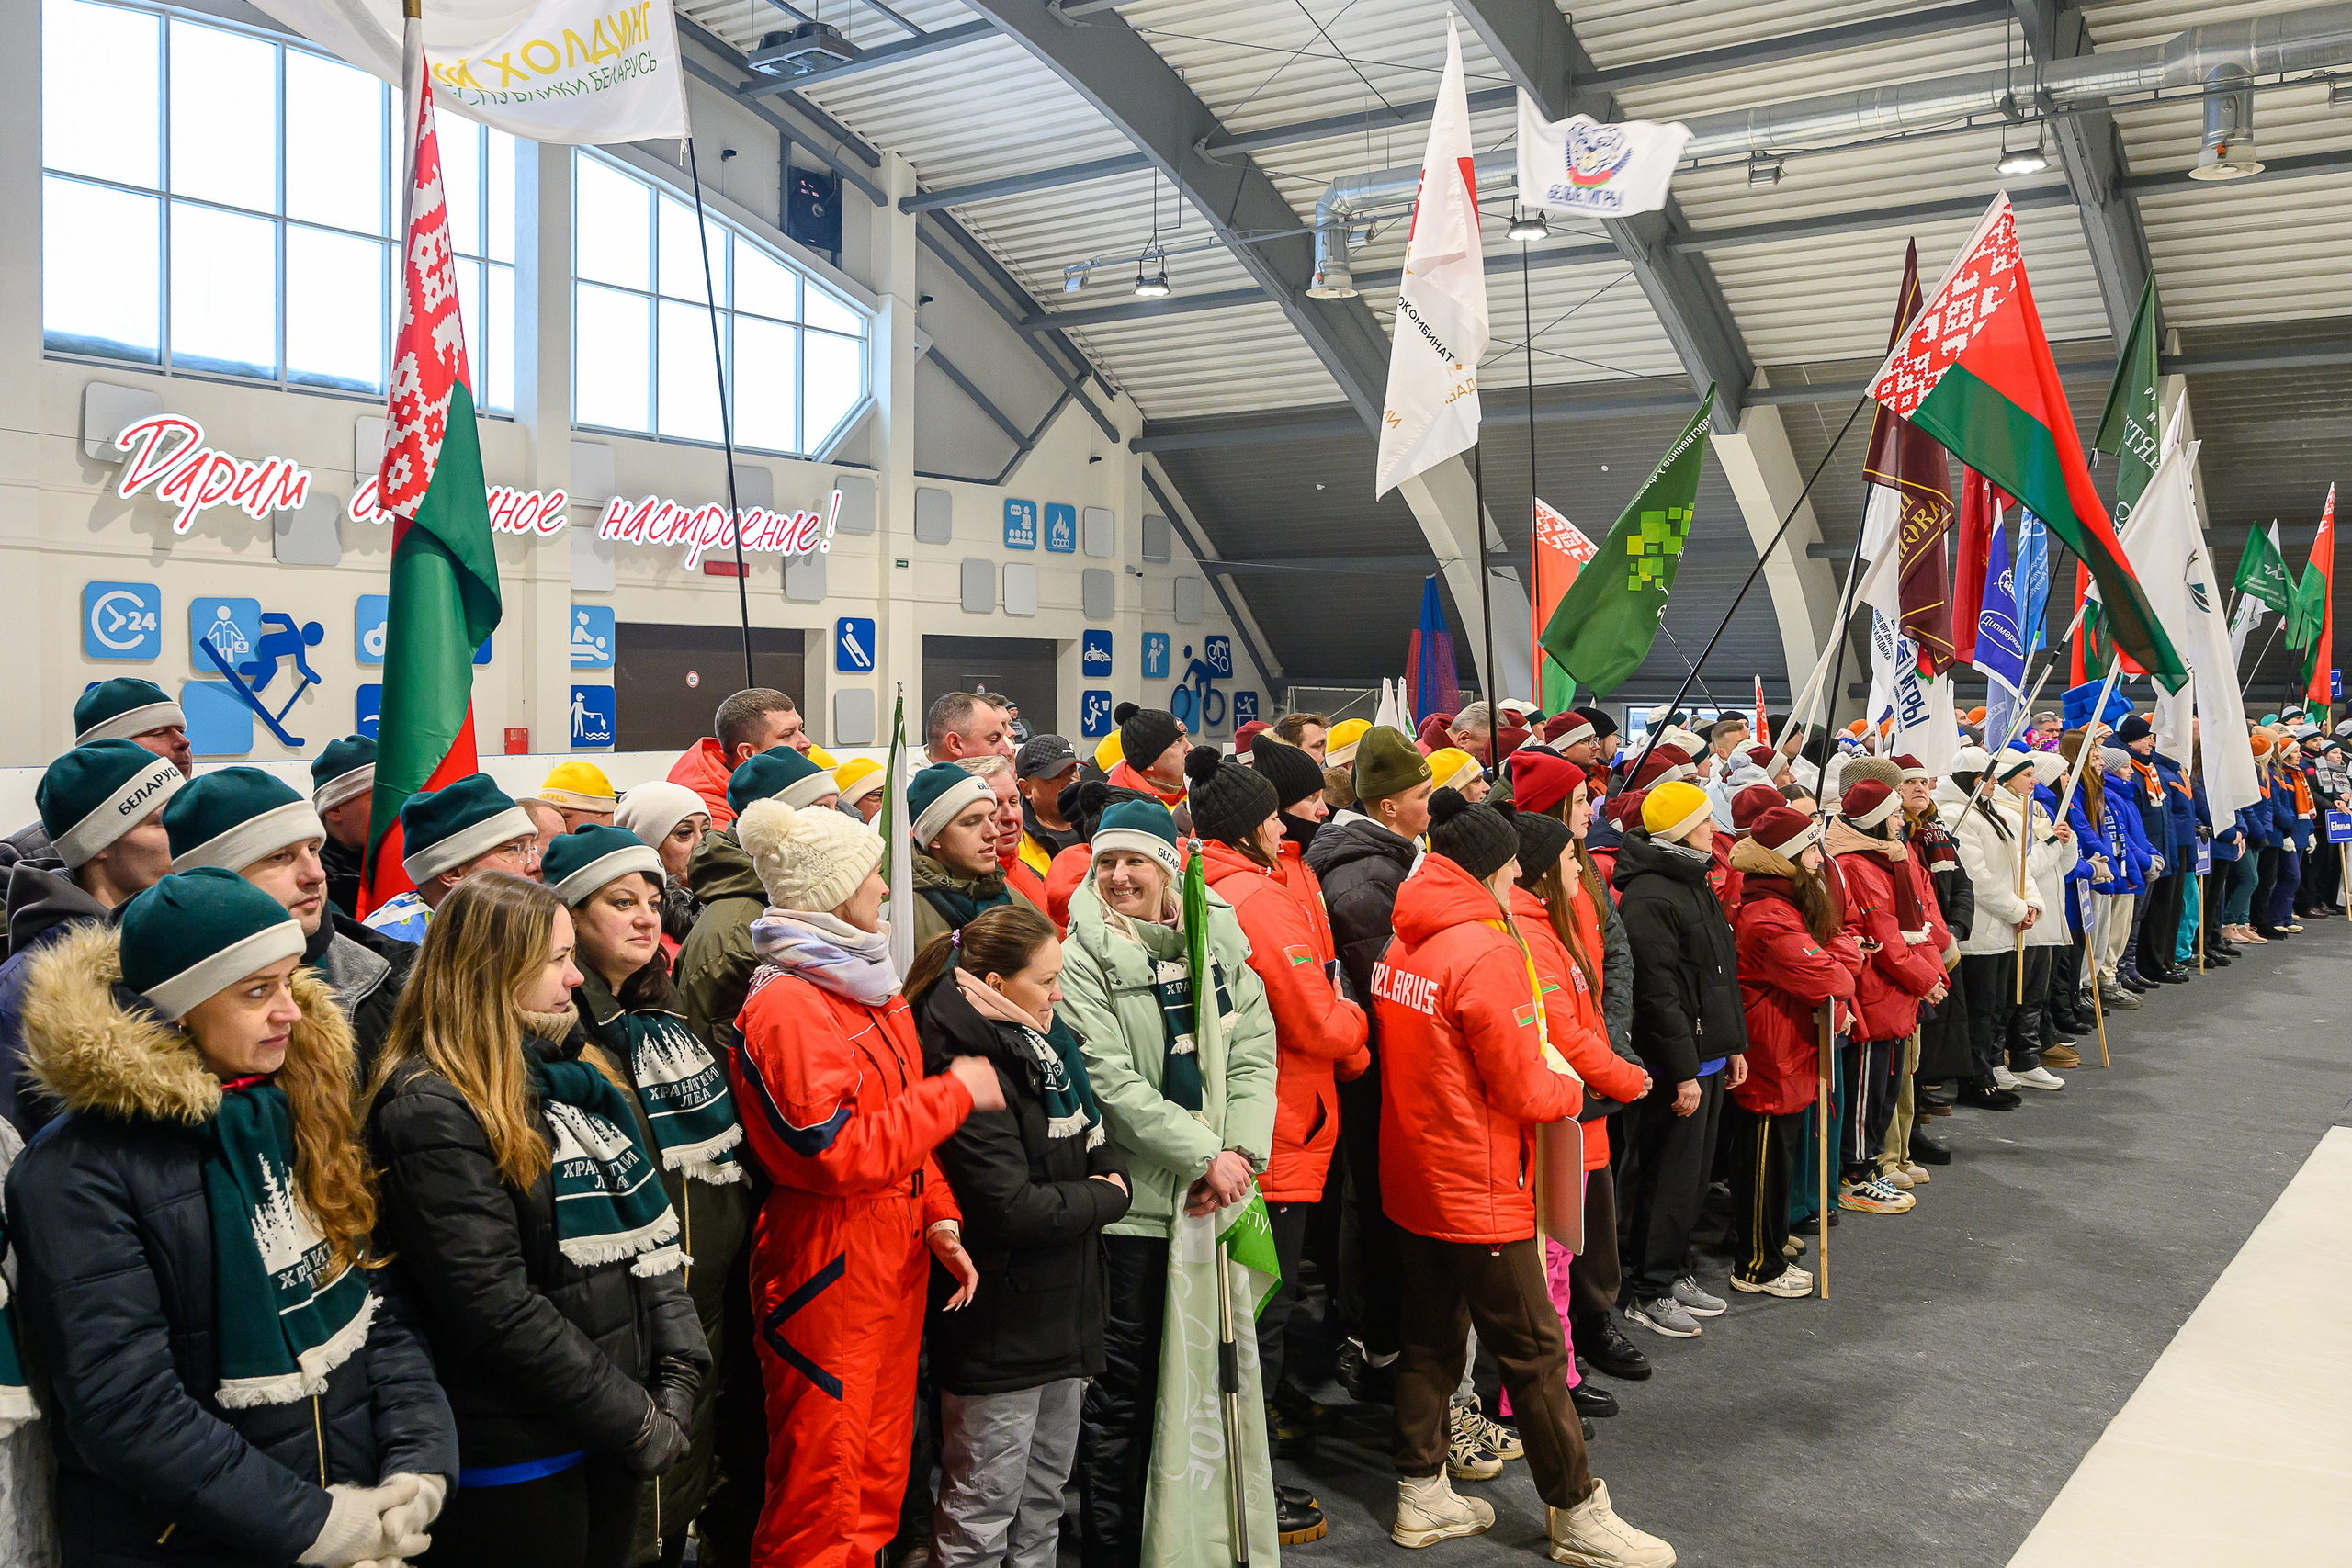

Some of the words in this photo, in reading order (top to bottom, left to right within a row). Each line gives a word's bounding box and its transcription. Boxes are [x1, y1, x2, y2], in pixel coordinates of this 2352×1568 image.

[481, 1, 650, 88] ХОЛДИНГ
[587, 51, 658, 92] БЕЛАРУСЬ
[118, 415, 311, 533] Дарим
[599, 491, 842, 569] настроение!
[128, 611, 157, 631] 24
[1899, 671, 1930, 729] ИГРЫ
